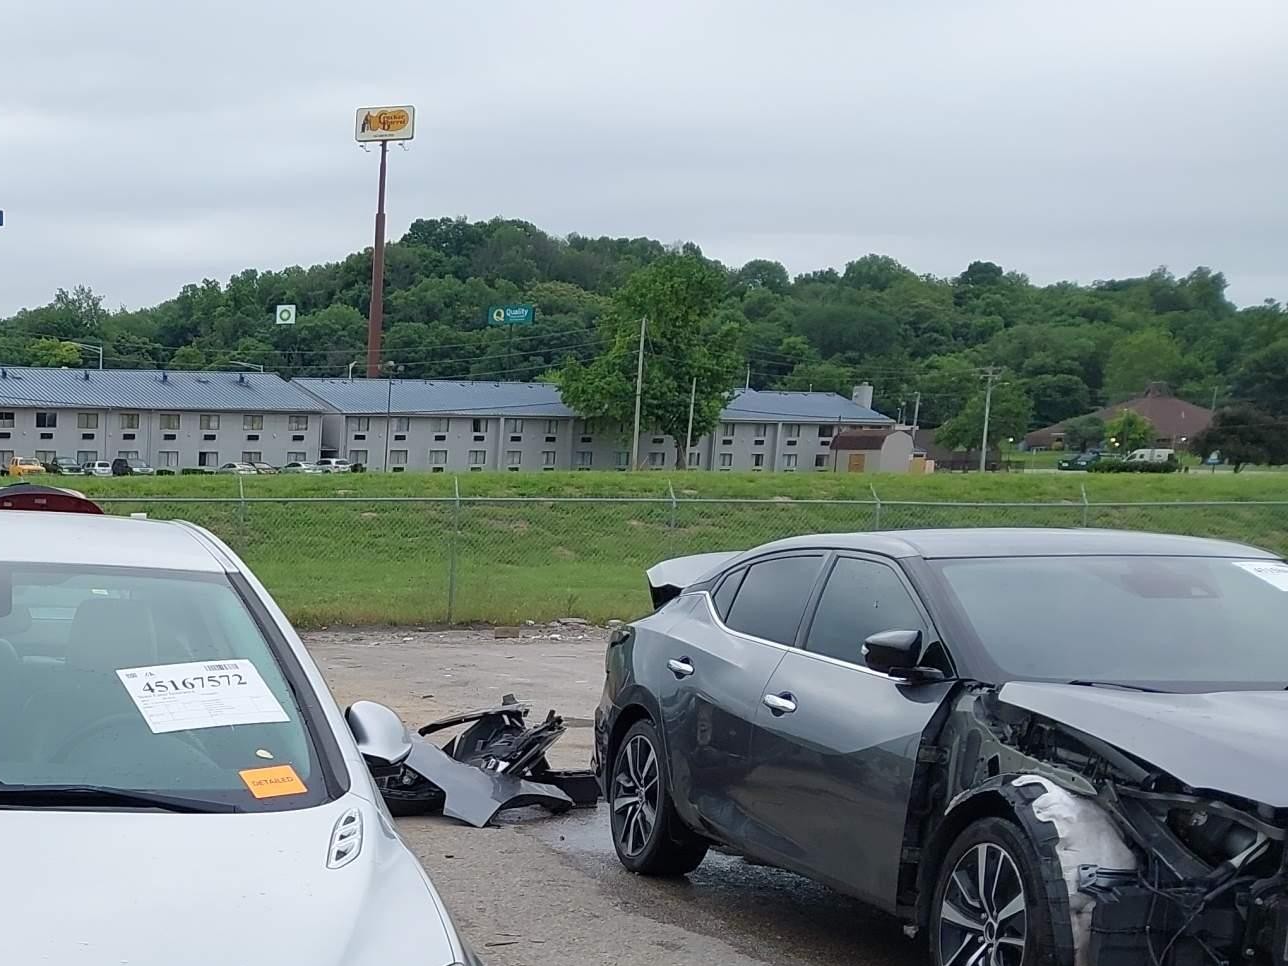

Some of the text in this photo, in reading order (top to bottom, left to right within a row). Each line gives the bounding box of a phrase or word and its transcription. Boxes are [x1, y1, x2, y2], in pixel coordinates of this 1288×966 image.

[505, 307, 529, 318] Quality
[142, 673, 248, 693] 45167572
[252, 776, 294, 787] DETAILED
